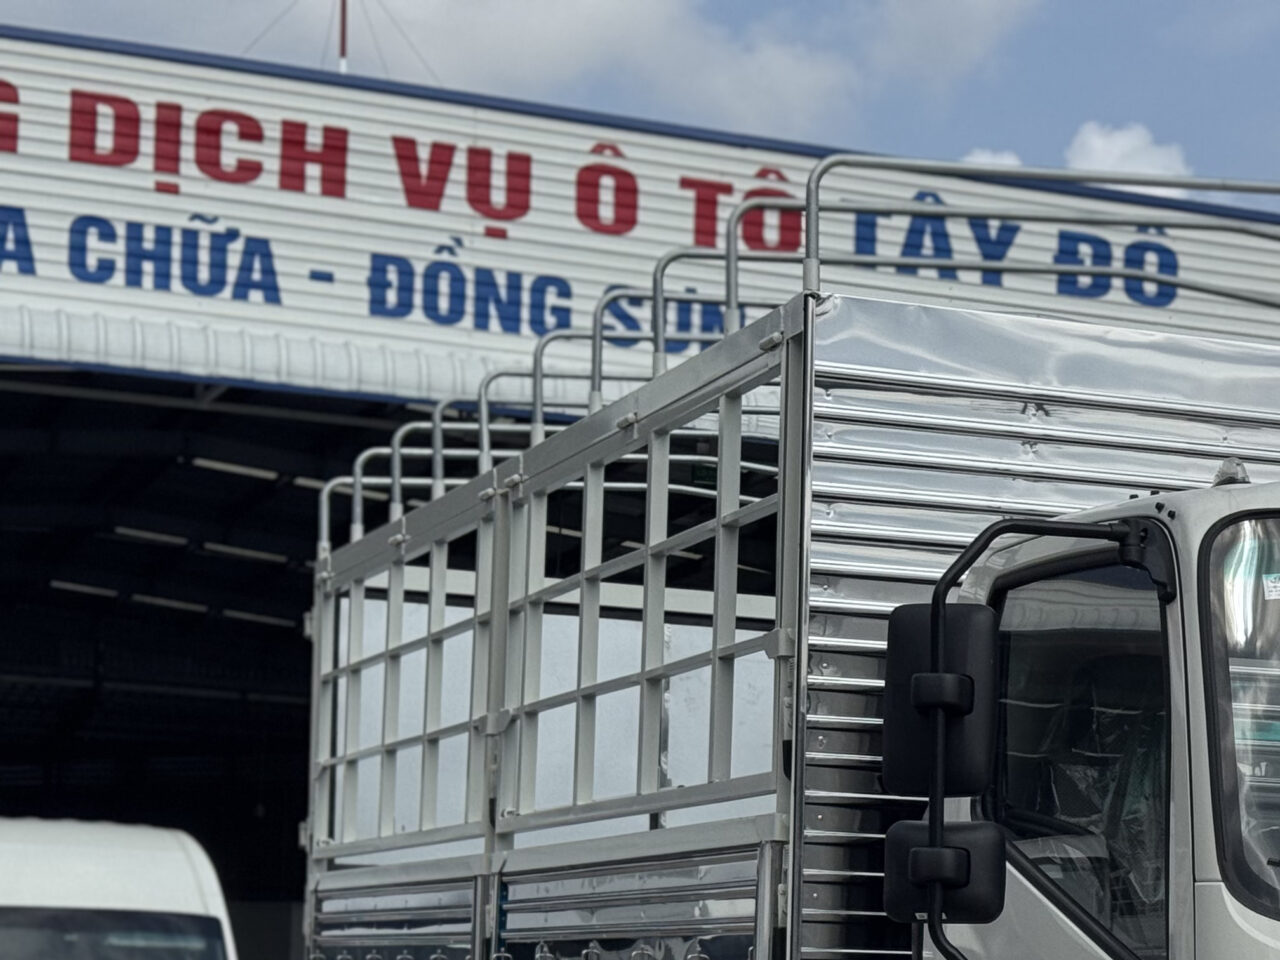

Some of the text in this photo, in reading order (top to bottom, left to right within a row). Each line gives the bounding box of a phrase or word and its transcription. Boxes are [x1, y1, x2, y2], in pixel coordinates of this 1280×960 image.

[68, 213, 283, 306] CHỮA
[367, 236, 573, 338] ĐỒNG
[69, 88, 348, 199] DỊCH
[391, 136, 532, 239] VỤ
[575, 142, 638, 236] Ô
[679, 164, 803, 253] TÔ
[850, 190, 1022, 288] TÂY
[1052, 224, 1179, 308] ĐÔ
